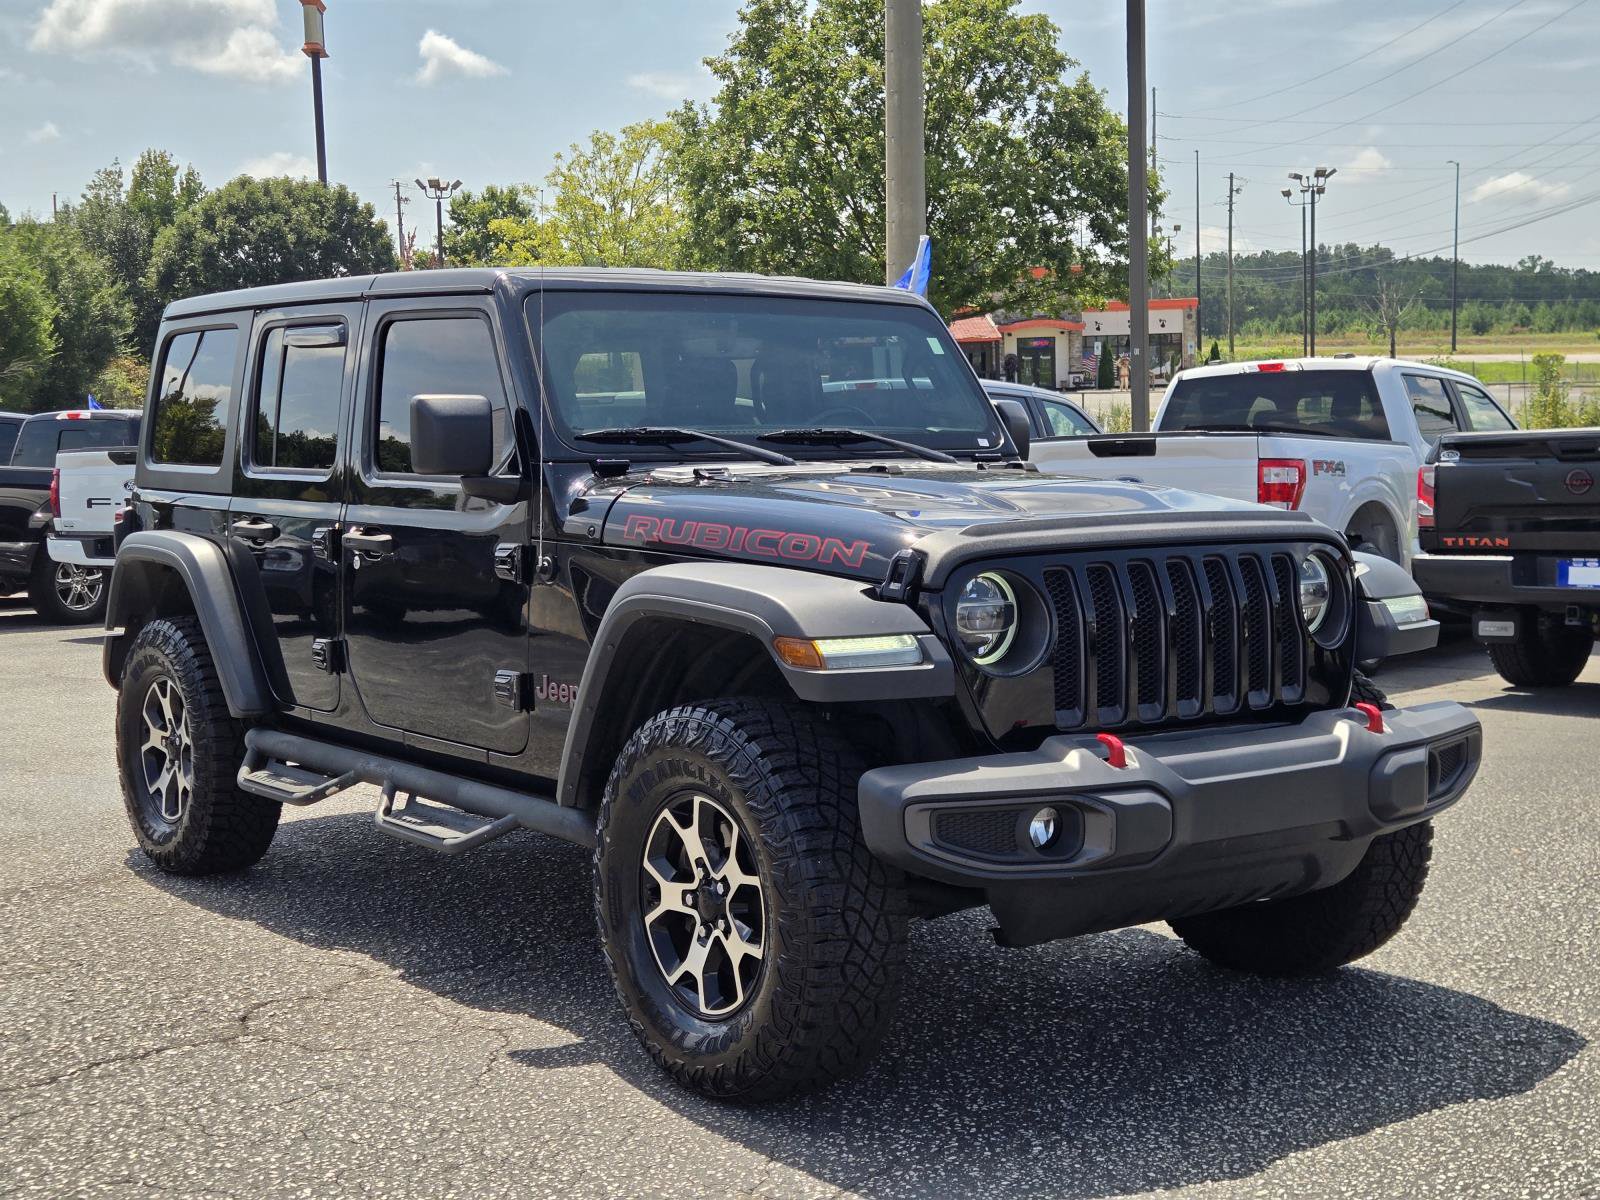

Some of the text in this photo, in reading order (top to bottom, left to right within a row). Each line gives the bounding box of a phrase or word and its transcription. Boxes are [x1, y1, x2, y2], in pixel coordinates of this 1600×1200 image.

[1312, 460, 1346, 476] FX4
[623, 515, 870, 568] RUBICON
[1442, 537, 1509, 547] TITAN
[535, 674, 579, 710] Jeep
